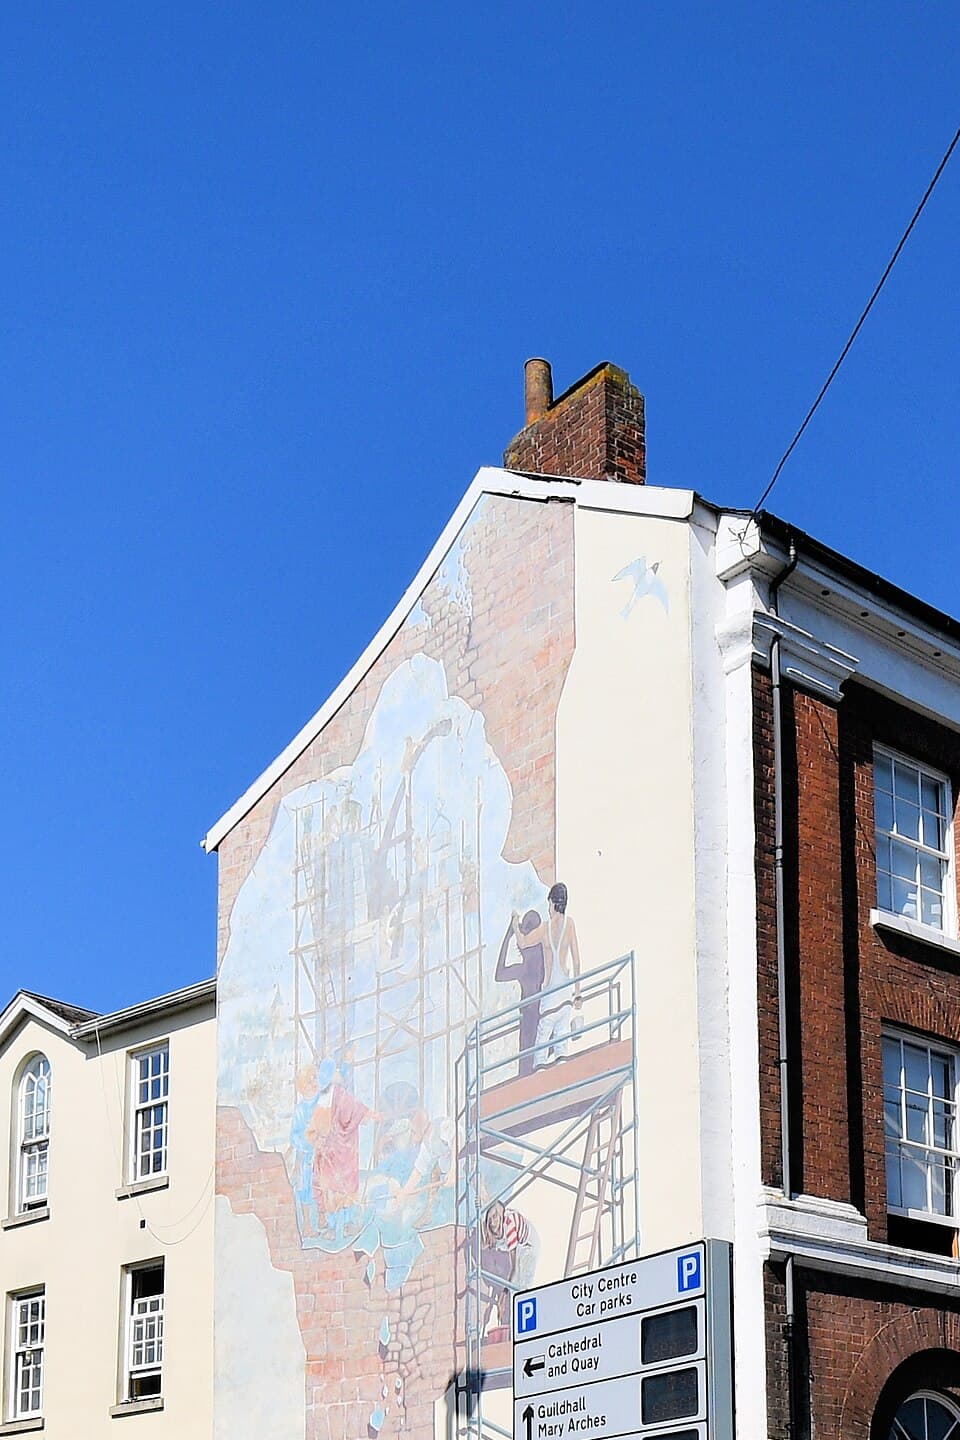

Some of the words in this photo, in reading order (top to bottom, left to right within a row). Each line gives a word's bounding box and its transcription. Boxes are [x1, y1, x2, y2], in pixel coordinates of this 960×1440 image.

[681, 1256, 697, 1289] P
[571, 1283, 593, 1300] City
[598, 1272, 637, 1292] Centre
[521, 1301, 533, 1330] P
[577, 1302, 597, 1317] Car
[600, 1294, 632, 1314] parks
[548, 1333, 602, 1358] Cathedral
[548, 1362, 567, 1378] and
[571, 1355, 600, 1372] Quay
[538, 1397, 585, 1418] Guildhall
[538, 1420, 564, 1439] Mary
[568, 1414, 606, 1431] Arches
